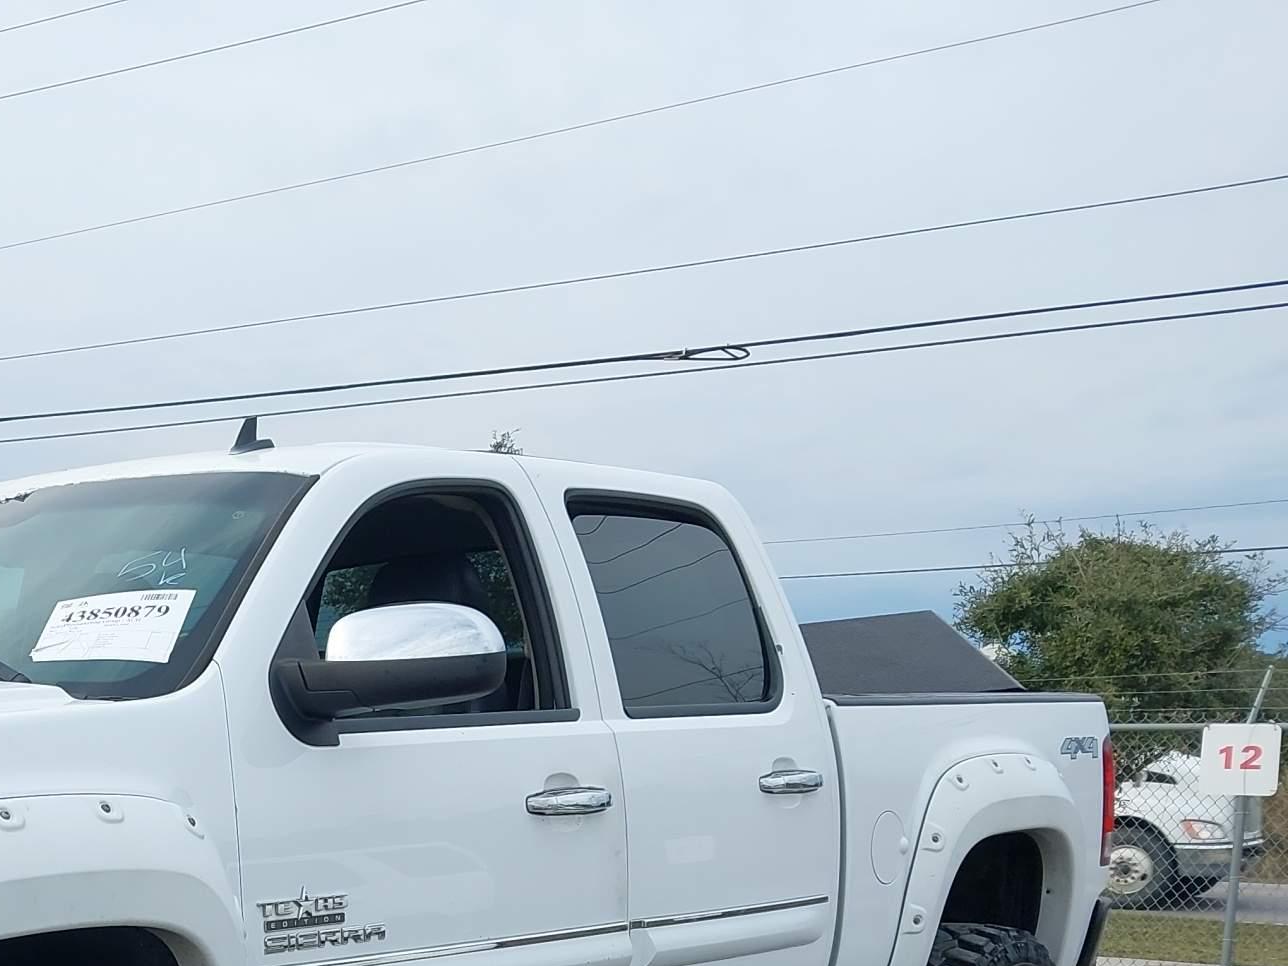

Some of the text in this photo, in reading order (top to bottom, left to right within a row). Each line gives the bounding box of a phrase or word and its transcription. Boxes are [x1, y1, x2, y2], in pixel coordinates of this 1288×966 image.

[61, 604, 171, 623] 43850879
[1218, 745, 1262, 770] 12
[256, 888, 348, 918] TEXAS
[270, 914, 341, 929] EDITION
[264, 924, 386, 954] SIERRA
